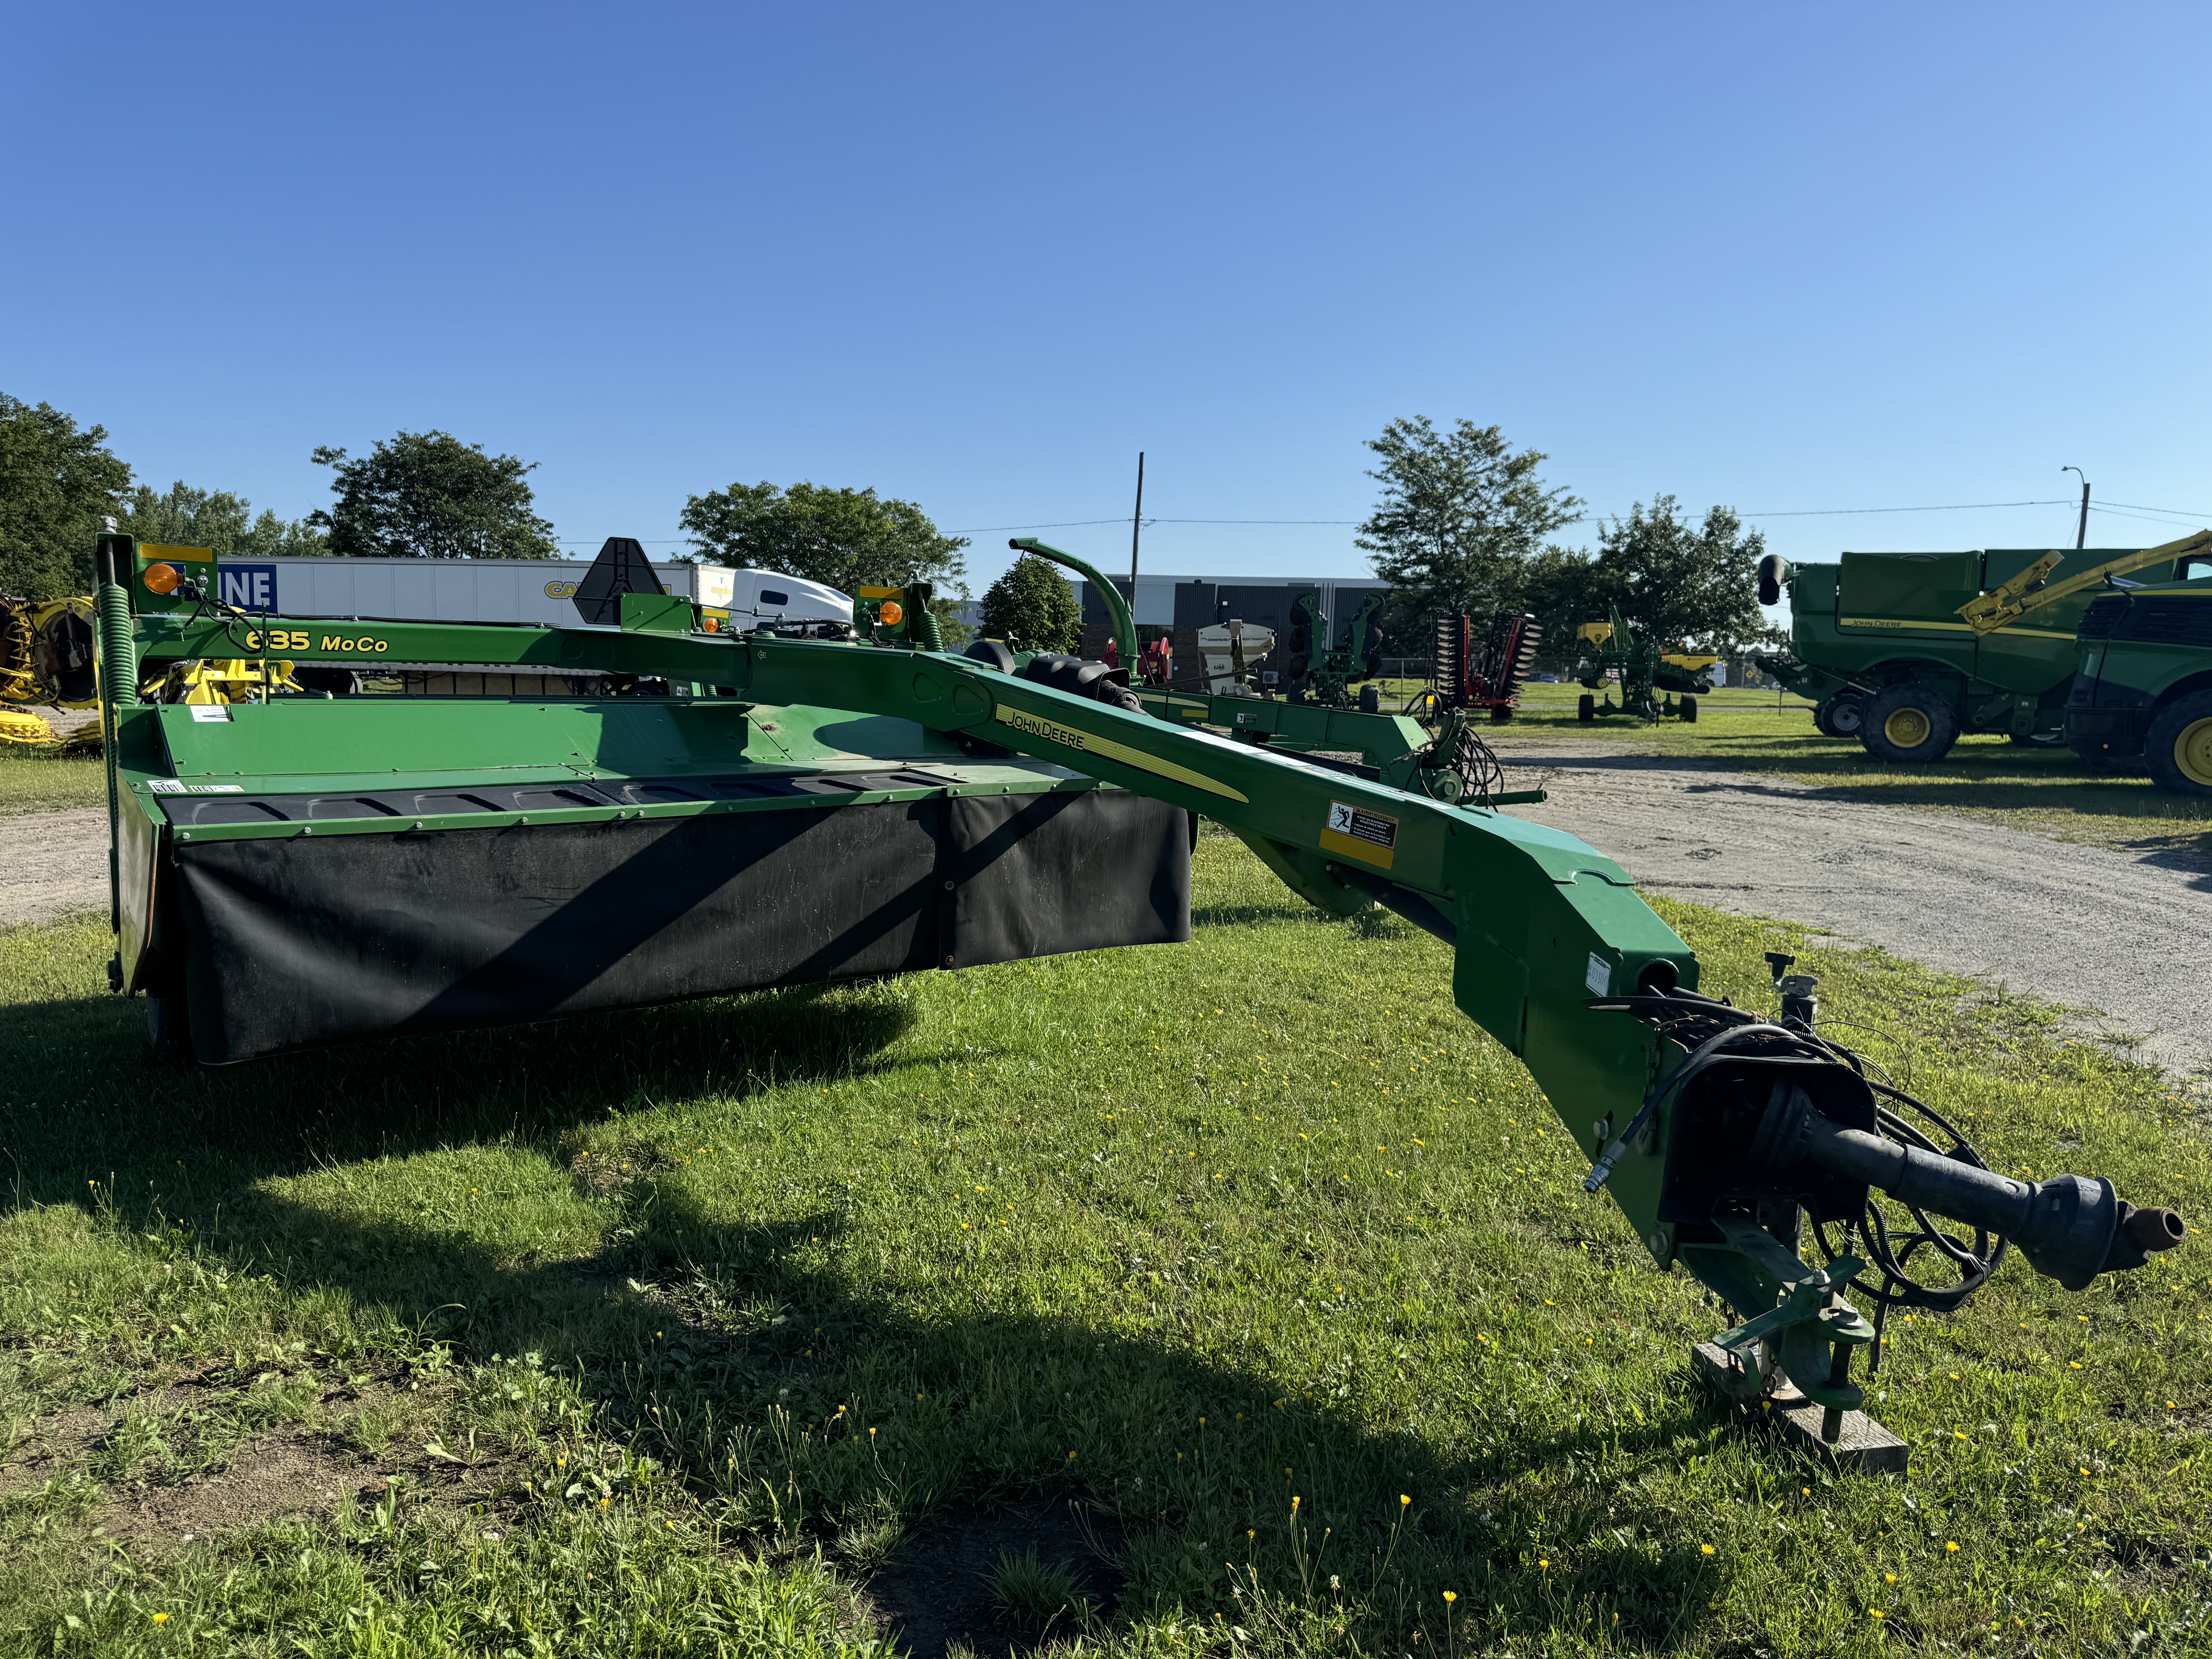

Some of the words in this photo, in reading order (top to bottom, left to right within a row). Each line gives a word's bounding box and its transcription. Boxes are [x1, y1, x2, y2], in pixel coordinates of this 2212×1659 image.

[246, 630, 310, 650] 635
[320, 636, 388, 652] MoCo
[1007, 712, 1041, 735] JOHN
[1041, 721, 1084, 749] DEERE
